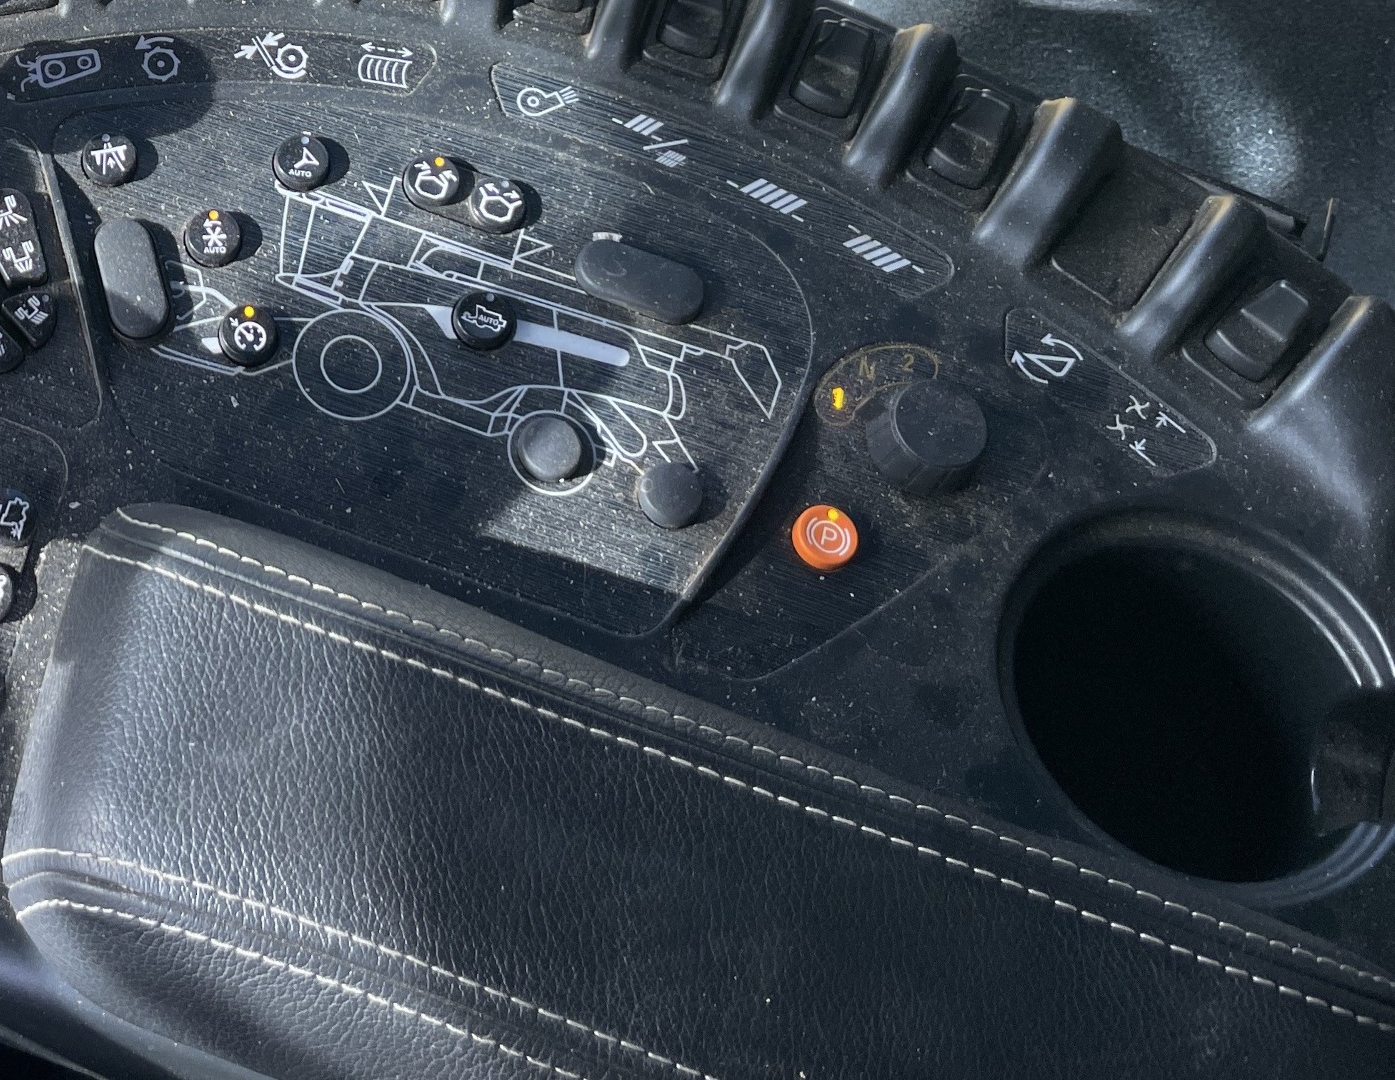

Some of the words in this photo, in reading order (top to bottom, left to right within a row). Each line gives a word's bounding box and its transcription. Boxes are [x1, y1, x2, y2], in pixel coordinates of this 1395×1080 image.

[288, 168, 312, 178] AUTO
[203, 246, 227, 254] AUTO
[478, 314, 499, 325] AUTO
[900, 353, 915, 373] 2
[820, 526, 838, 545] P
